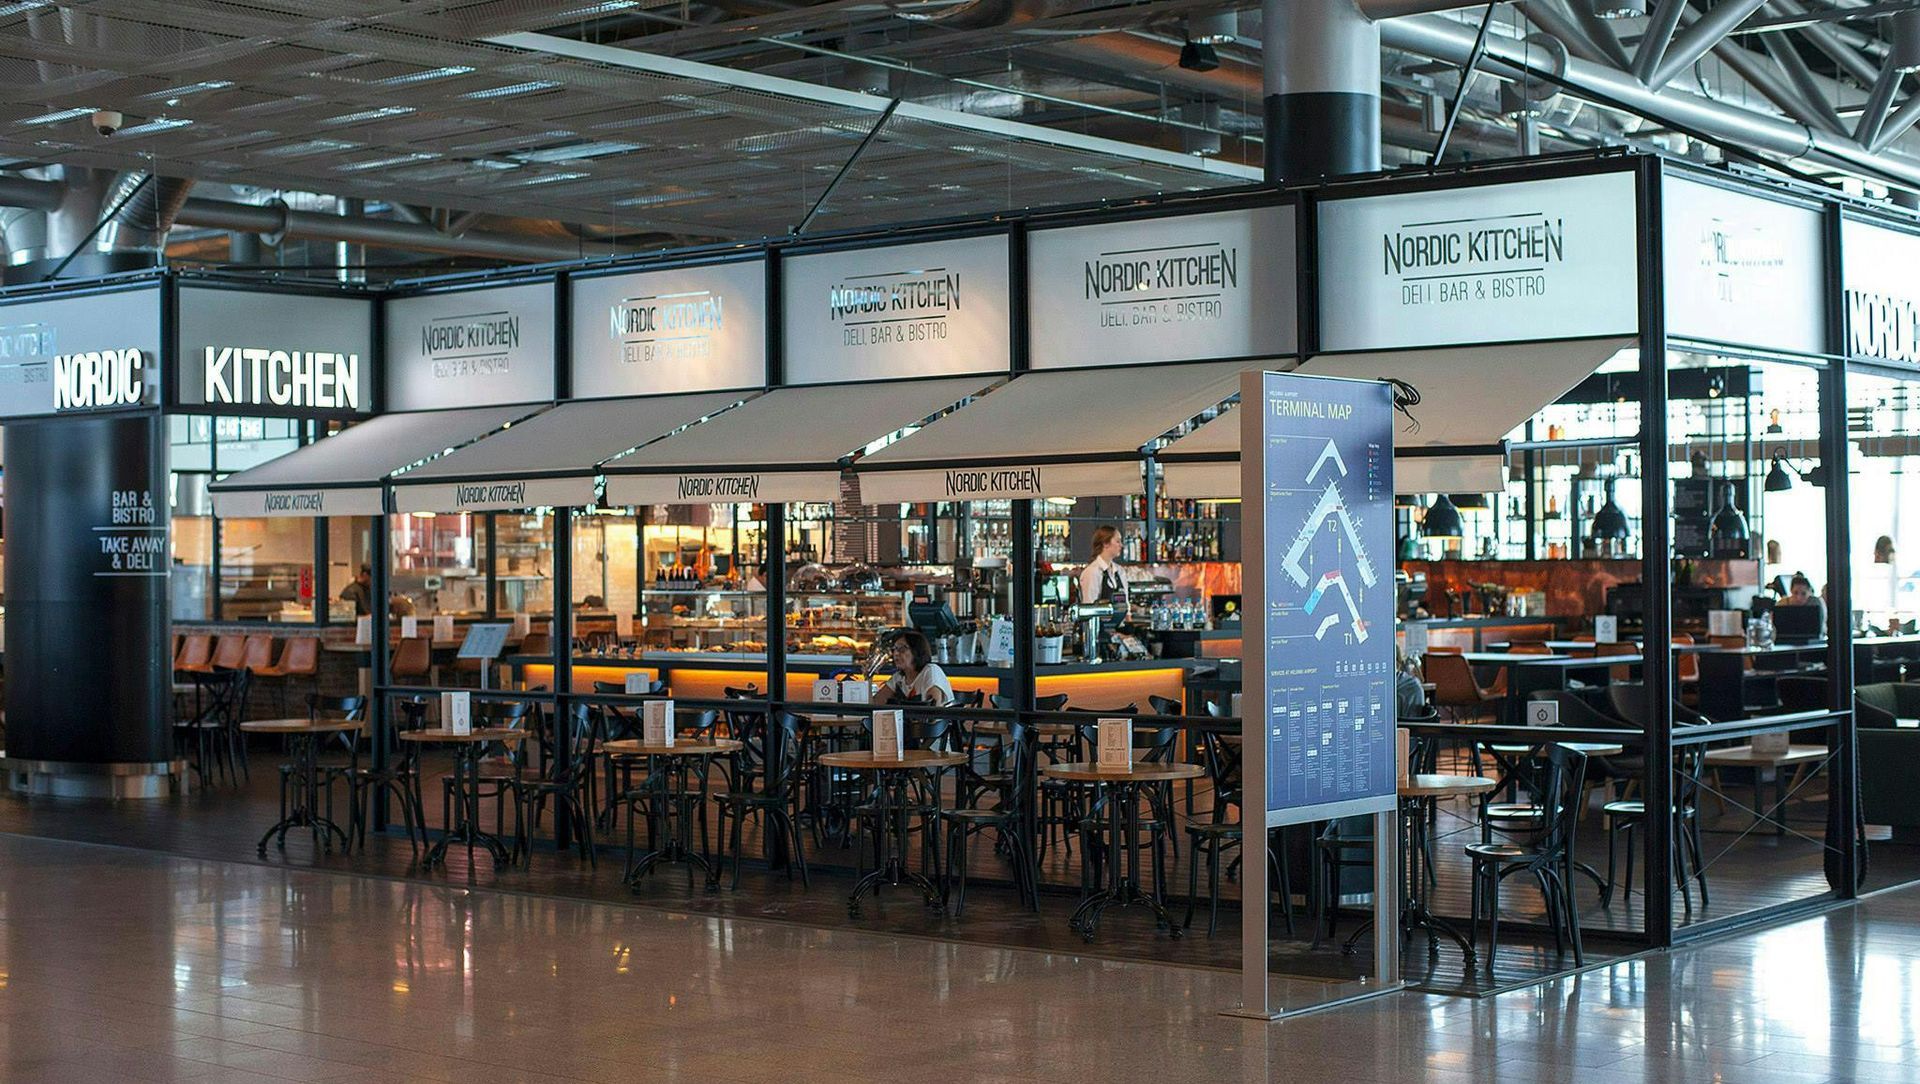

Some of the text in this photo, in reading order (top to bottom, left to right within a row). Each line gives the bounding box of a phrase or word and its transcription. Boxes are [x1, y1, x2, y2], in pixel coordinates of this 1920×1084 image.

[1384, 218, 1563, 275] NORDIC KITCHEN
[1085, 248, 1237, 300] NORDIC KITCHEN
[831, 273, 960, 321] NORDIC KITCHEN
[1440, 281, 1468, 302] BAR
[1475, 280, 1485, 300] &
[1493, 275, 1545, 298] BISTRO
[610, 296, 722, 340] NORDIC KITCHEN
[422, 315, 519, 356] NORDIC KITCHEN
[871, 326, 892, 344] BAR
[896, 324, 904, 342] &
[909, 321, 948, 340] BISTRO
[54, 347, 142, 409] NORDIC
[204, 346, 359, 409] KITCHEN
[1269, 399, 1352, 420] TERMINAL MAP
[678, 474, 759, 499] NORDIC KITCHEN
[945, 467, 1041, 496] NORDIC KITCHEN
[112, 491, 152, 507] BAR &
[264, 492, 324, 513] NORDIC KITCHEN
[456, 482, 525, 506] NORDIC KITCHEN
[112, 507, 155, 523] BISTRO
[1327, 520, 1337, 532] T2
[99, 536, 165, 553] TAKE AWAY
[112, 553, 153, 569] & DELI
[1344, 633, 1352, 645] T1
